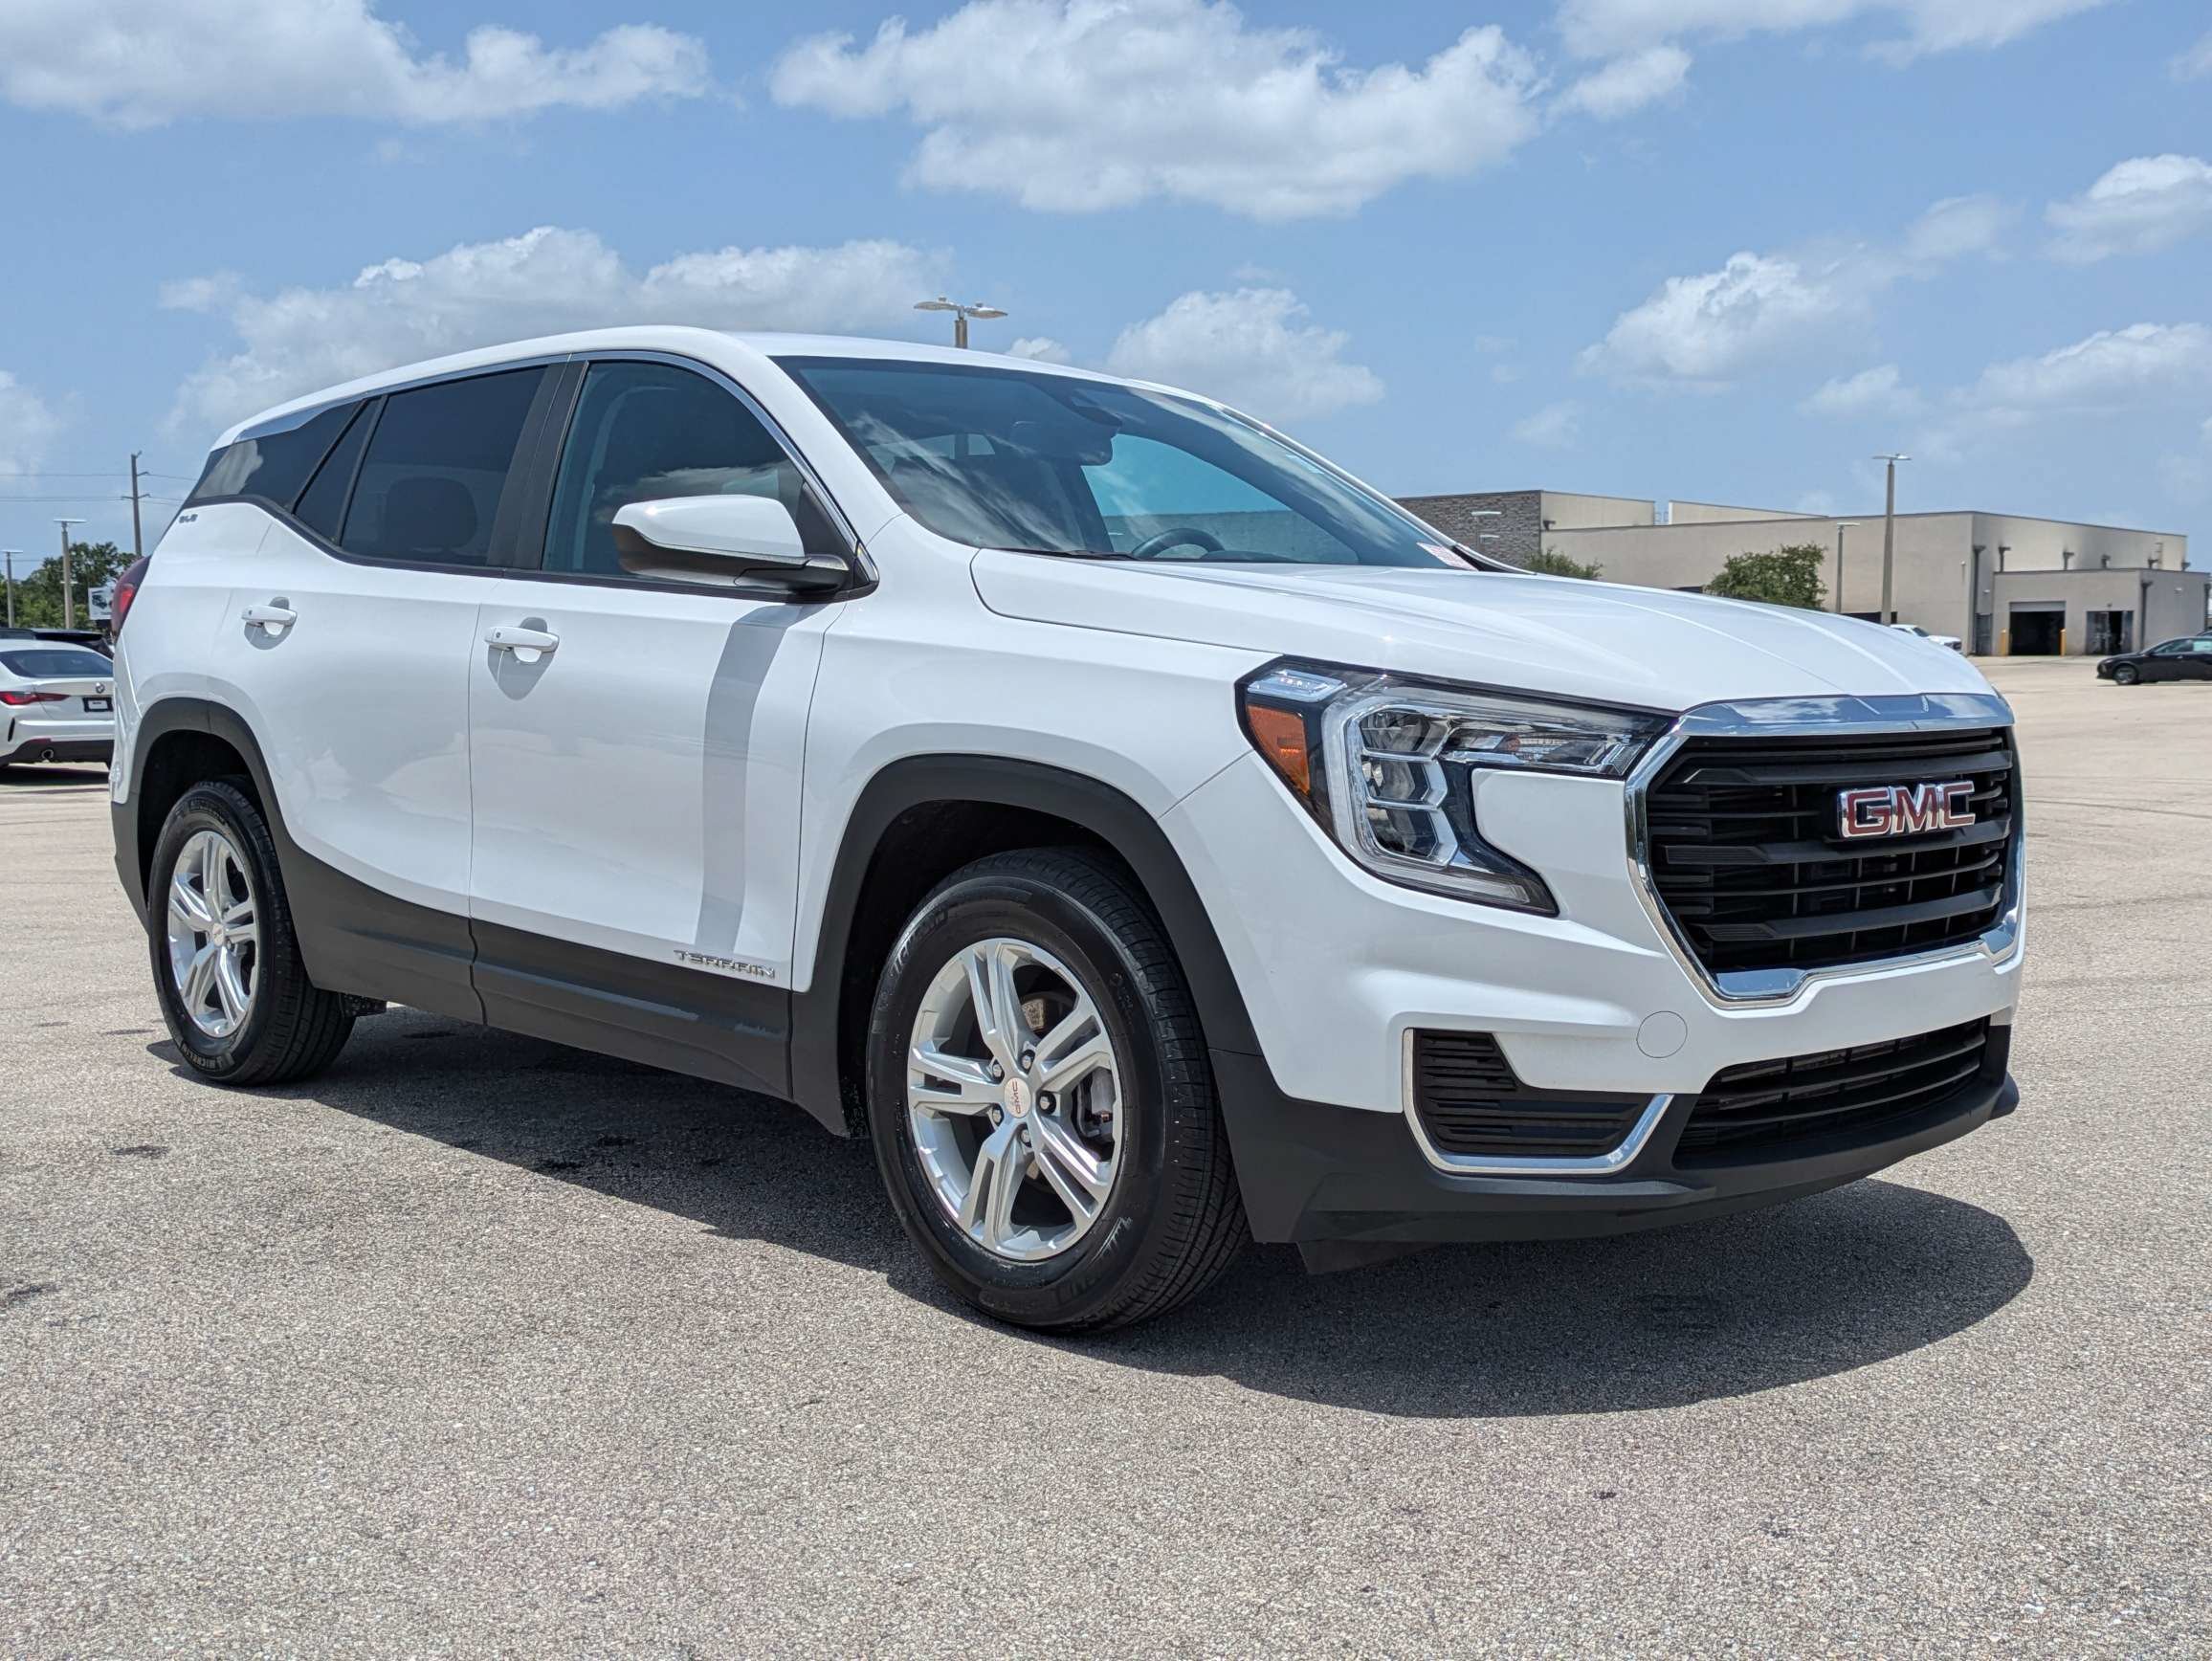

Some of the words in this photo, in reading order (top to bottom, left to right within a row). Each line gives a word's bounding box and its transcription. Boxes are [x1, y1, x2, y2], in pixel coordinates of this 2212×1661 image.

[1838, 780, 1976, 838] GMC
[674, 949, 776, 979] TERRAIN
[1011, 1080, 1022, 1115] GMC
